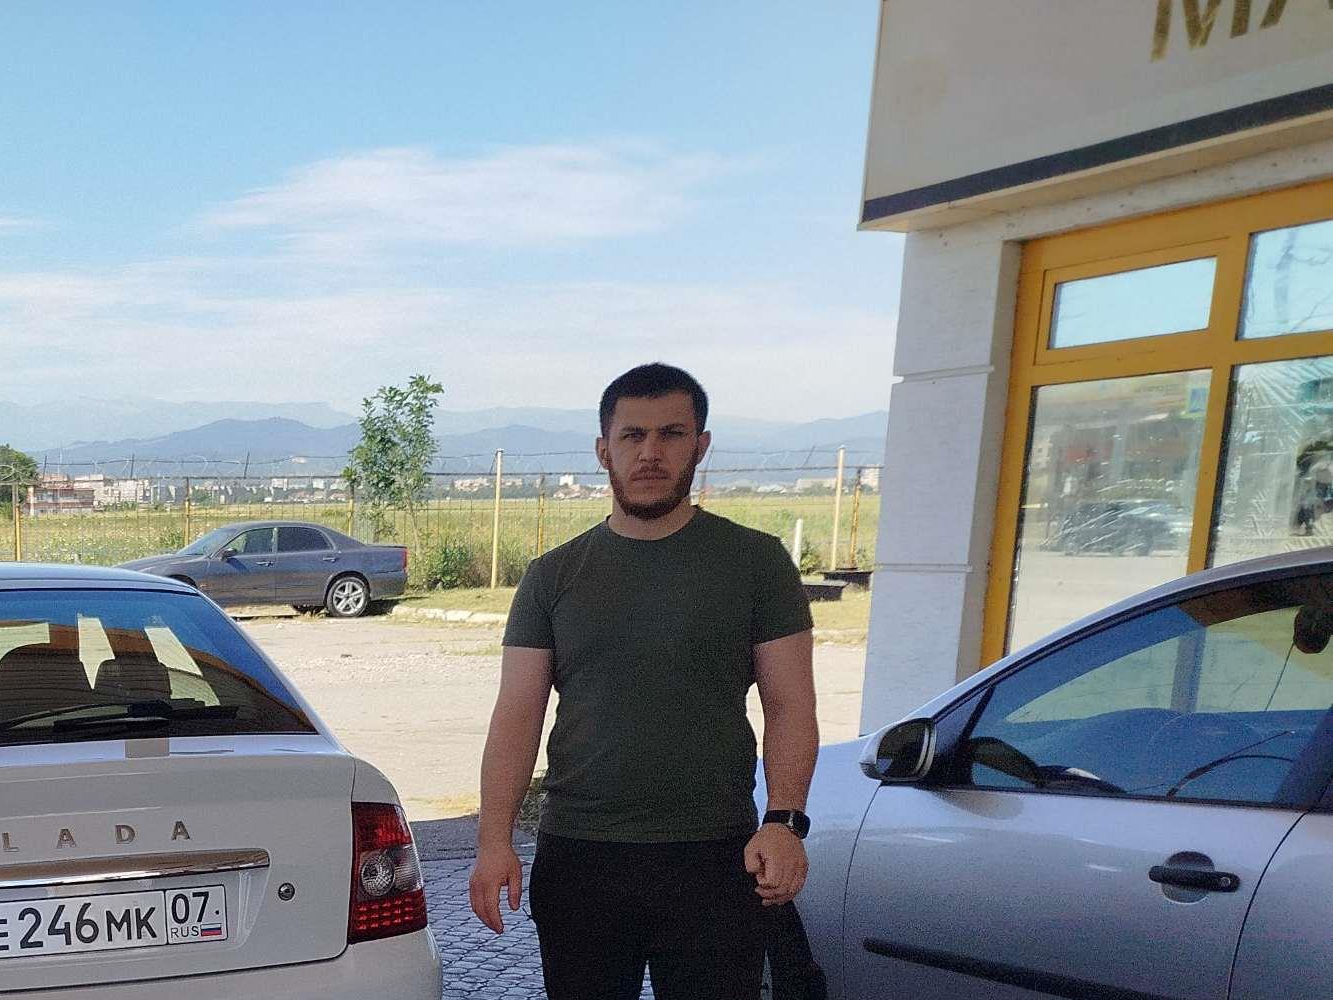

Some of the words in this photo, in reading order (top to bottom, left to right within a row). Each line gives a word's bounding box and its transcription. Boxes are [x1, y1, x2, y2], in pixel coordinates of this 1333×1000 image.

[2, 821, 190, 852] LADA
[171, 892, 209, 924] 07
[171, 926, 199, 938] RUS
